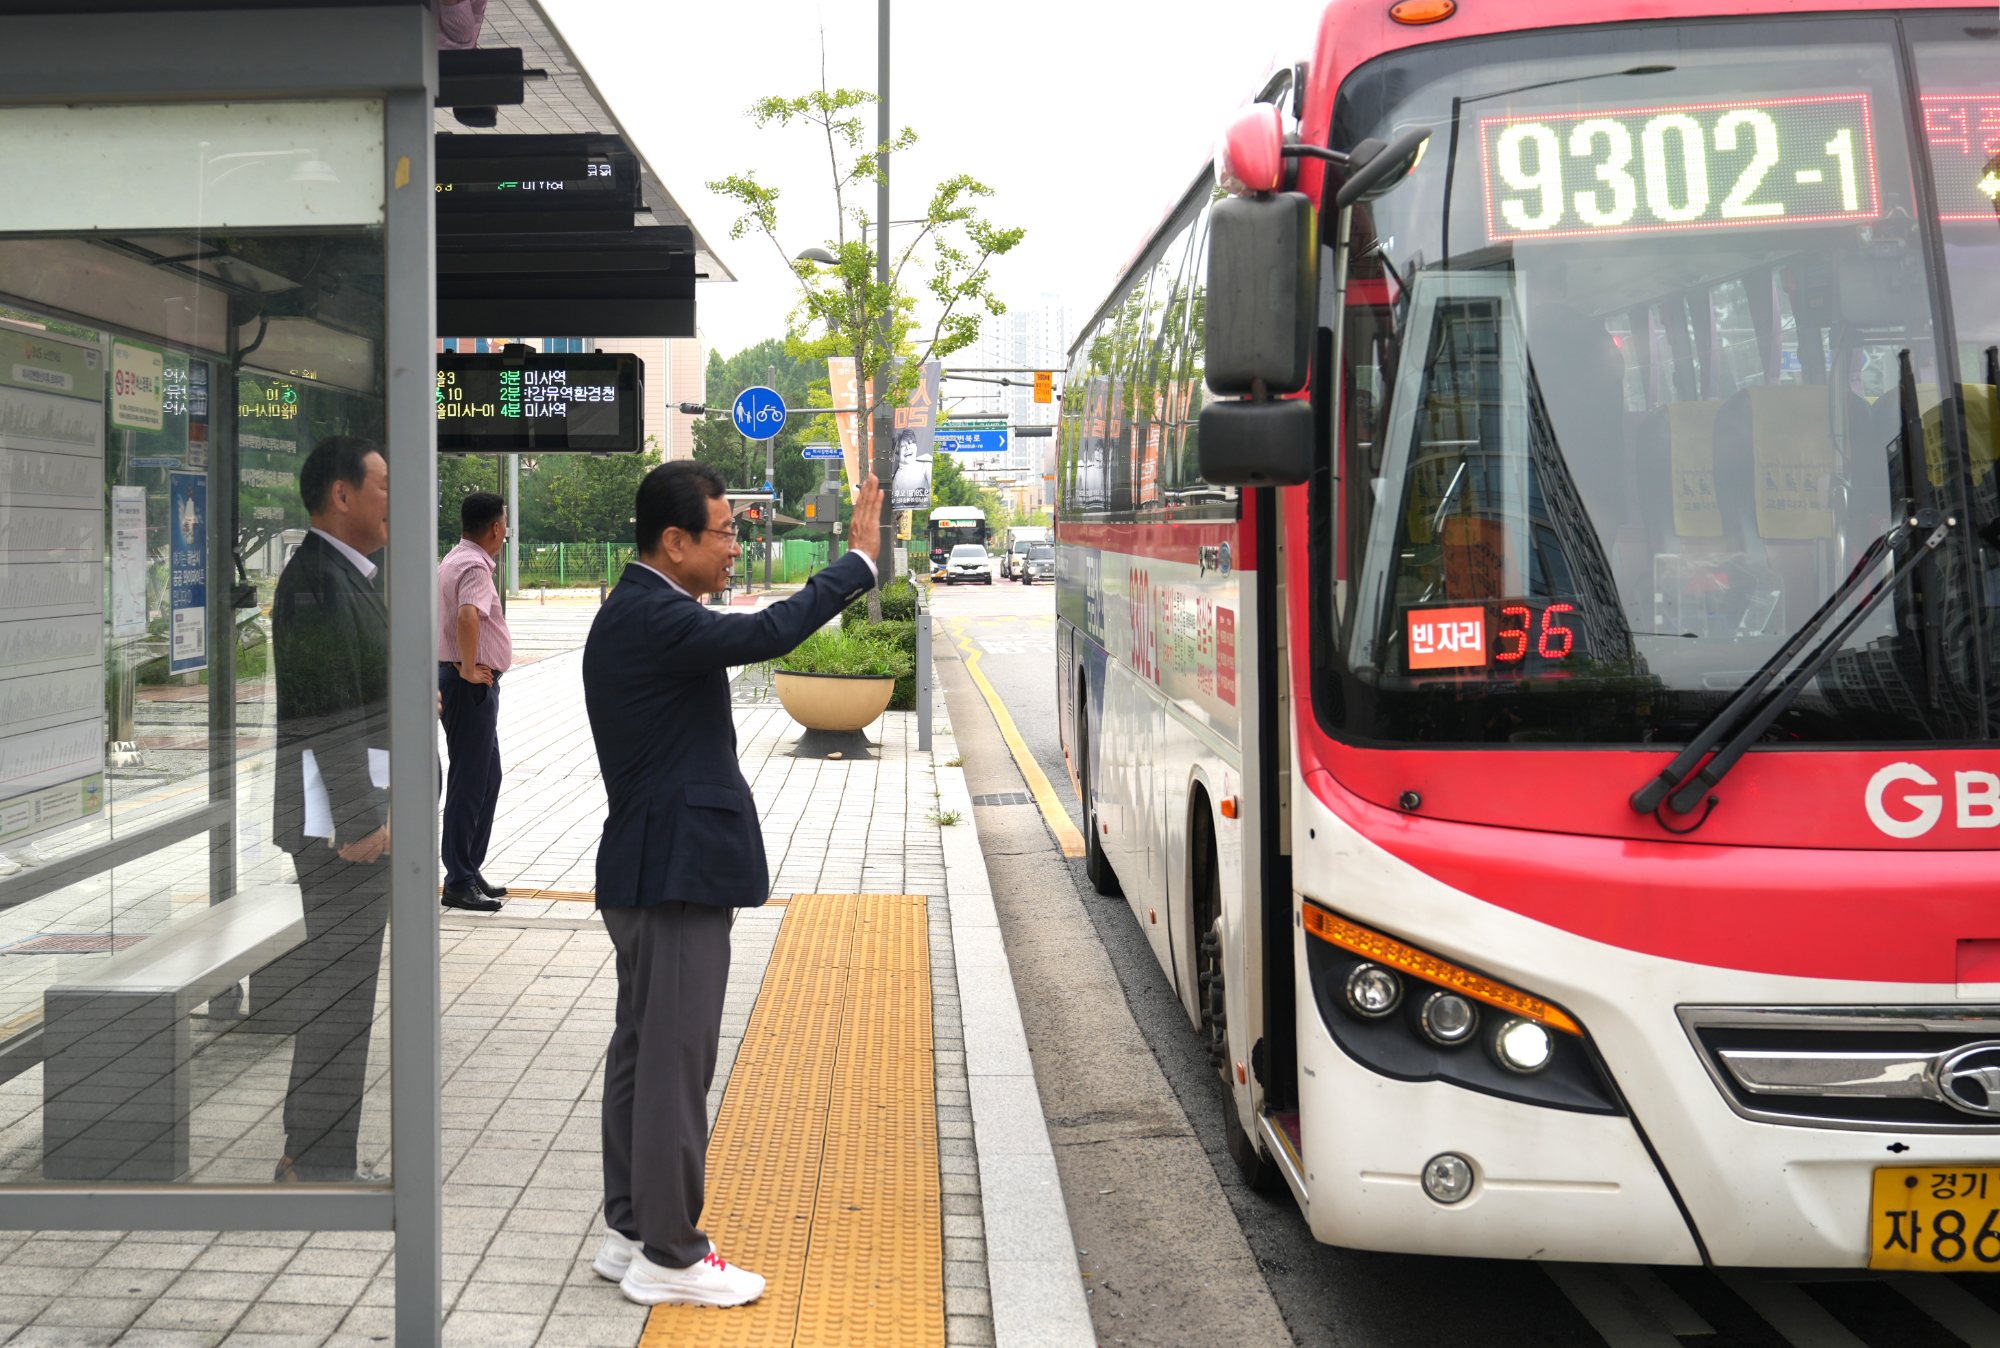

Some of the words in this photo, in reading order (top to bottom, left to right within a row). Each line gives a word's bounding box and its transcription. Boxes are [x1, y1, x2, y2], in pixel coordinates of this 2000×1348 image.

[1497, 108, 1859, 231] 9302-1
[500, 371, 520, 385] 3분
[524, 370, 566, 386] 미사역
[448, 388, 462, 401] 10
[500, 387, 520, 401] 2분
[500, 403, 520, 417] 4분
[524, 402, 566, 418] 미사역
[1129, 566, 1160, 687] 9302-1
[1411, 621, 1482, 654] 빈자리
[1496, 603, 1574, 661] 36
[1930, 1172, 1988, 1200] 경기
